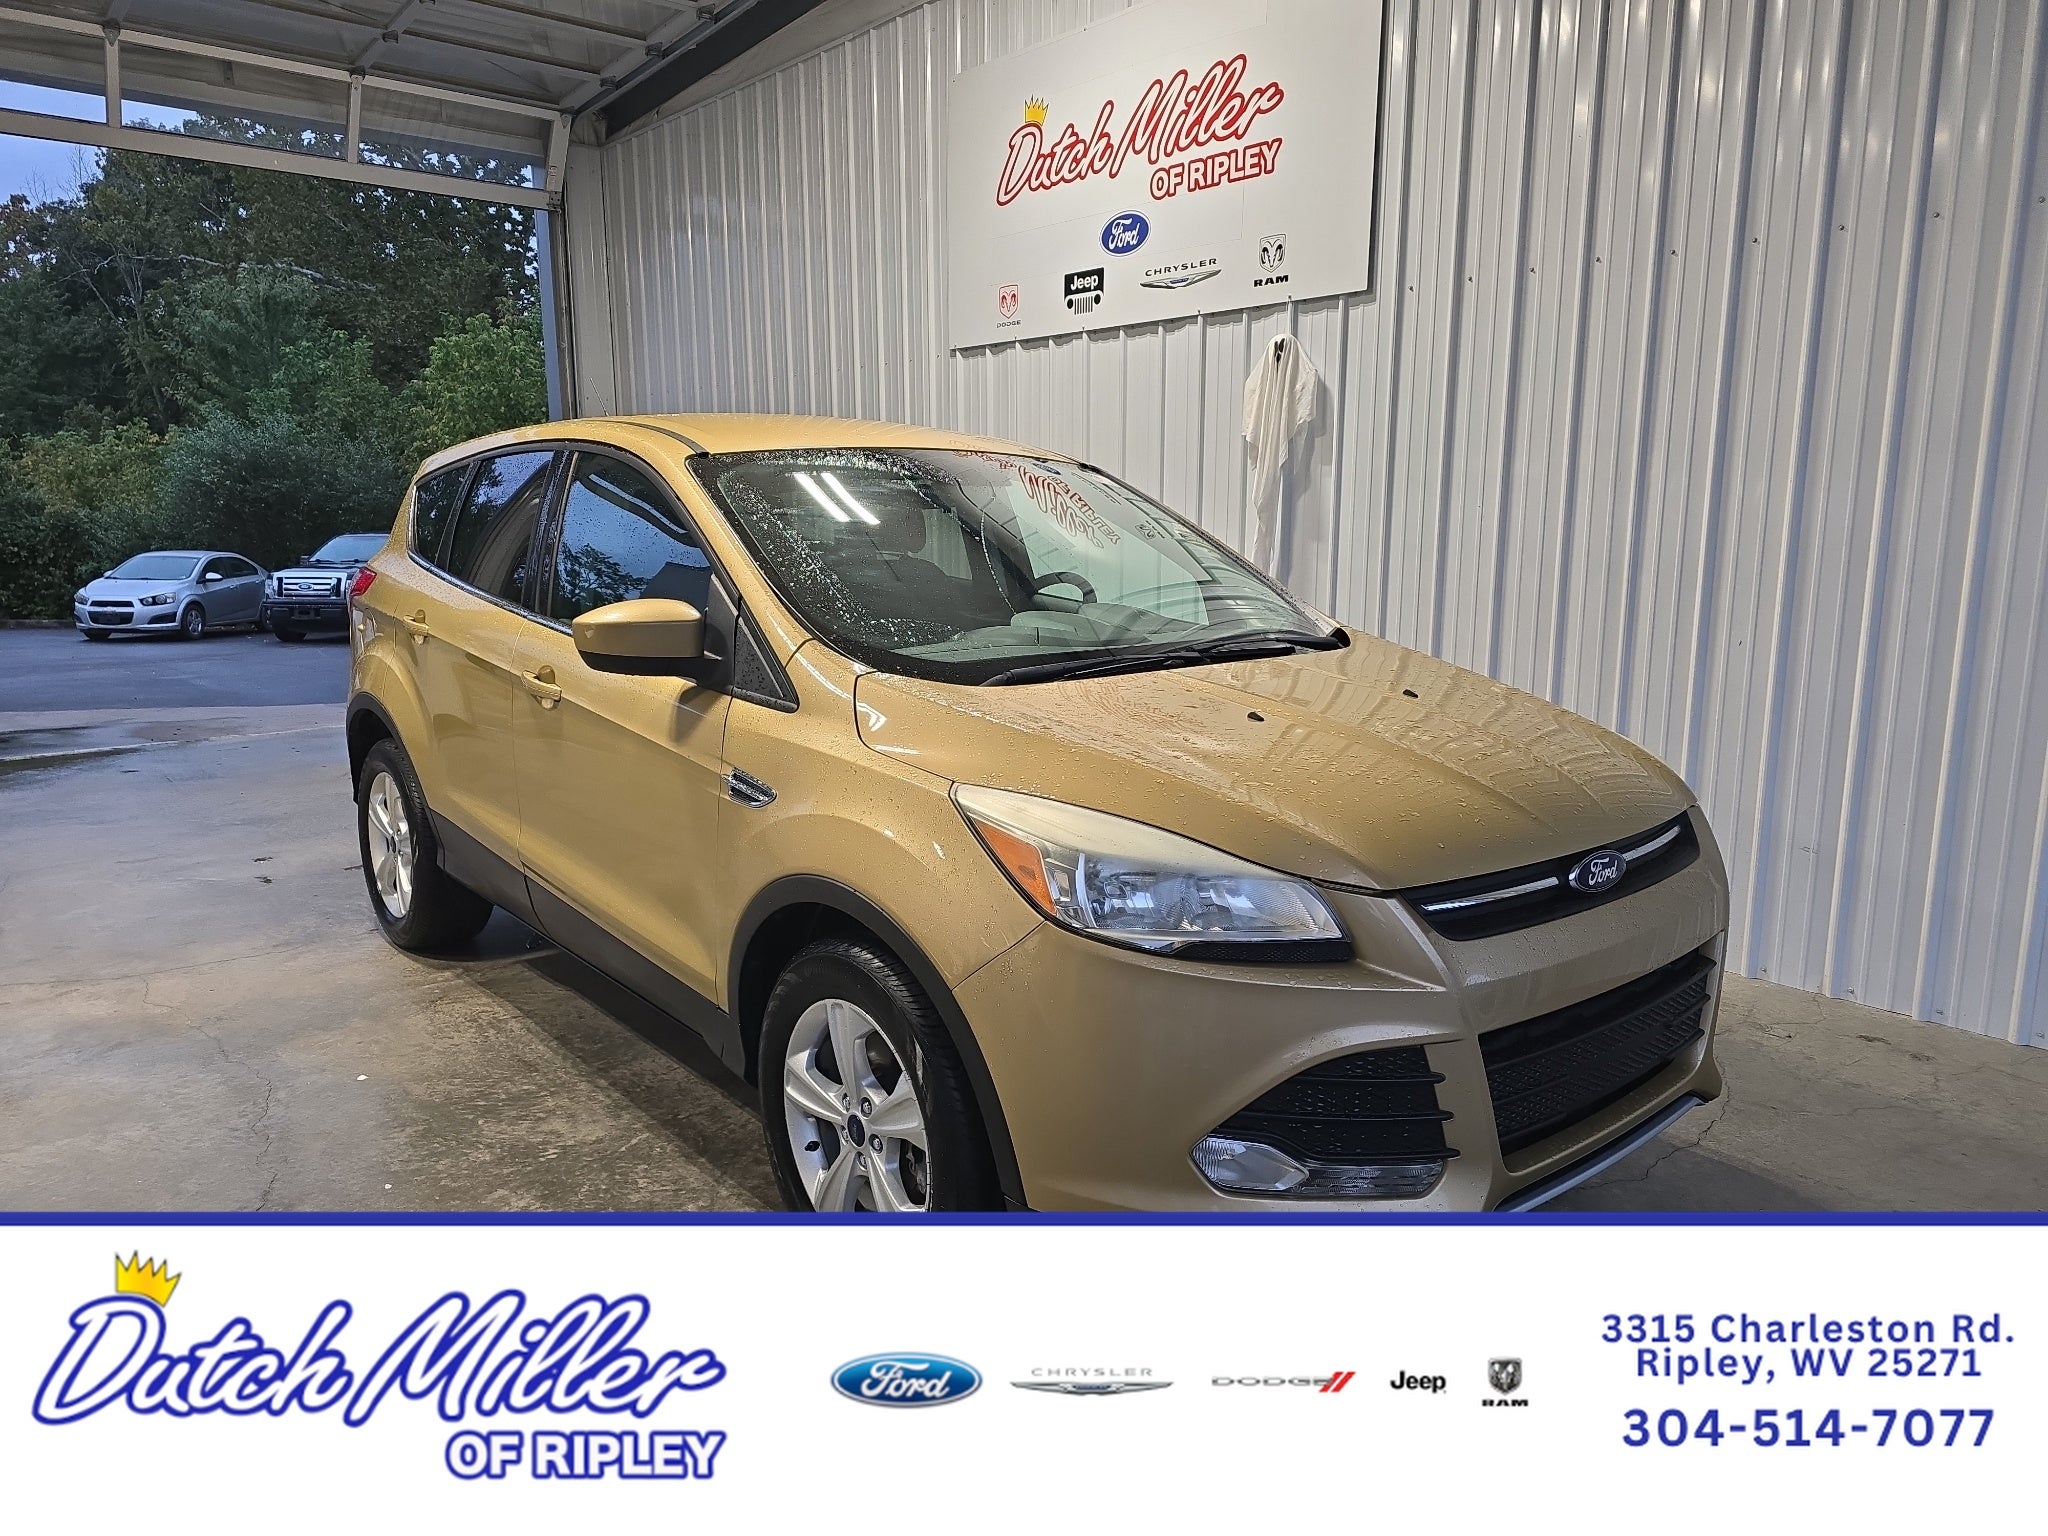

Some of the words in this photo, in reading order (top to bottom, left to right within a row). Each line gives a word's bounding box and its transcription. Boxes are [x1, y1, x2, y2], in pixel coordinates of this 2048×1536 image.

[996, 100, 1115, 207] Dutch
[1108, 54, 1284, 178] Miller
[1150, 161, 1187, 200] OF
[1187, 138, 1283, 192] RIPLEY
[1108, 218, 1140, 250] Ford
[1145, 258, 1217, 277] CHRYSLER
[1070, 274, 1099, 291] Jeep
[1253, 275, 1289, 287] RAM
[996, 319, 1022, 329] DODGE
[1588, 857, 1618, 886] Ford
